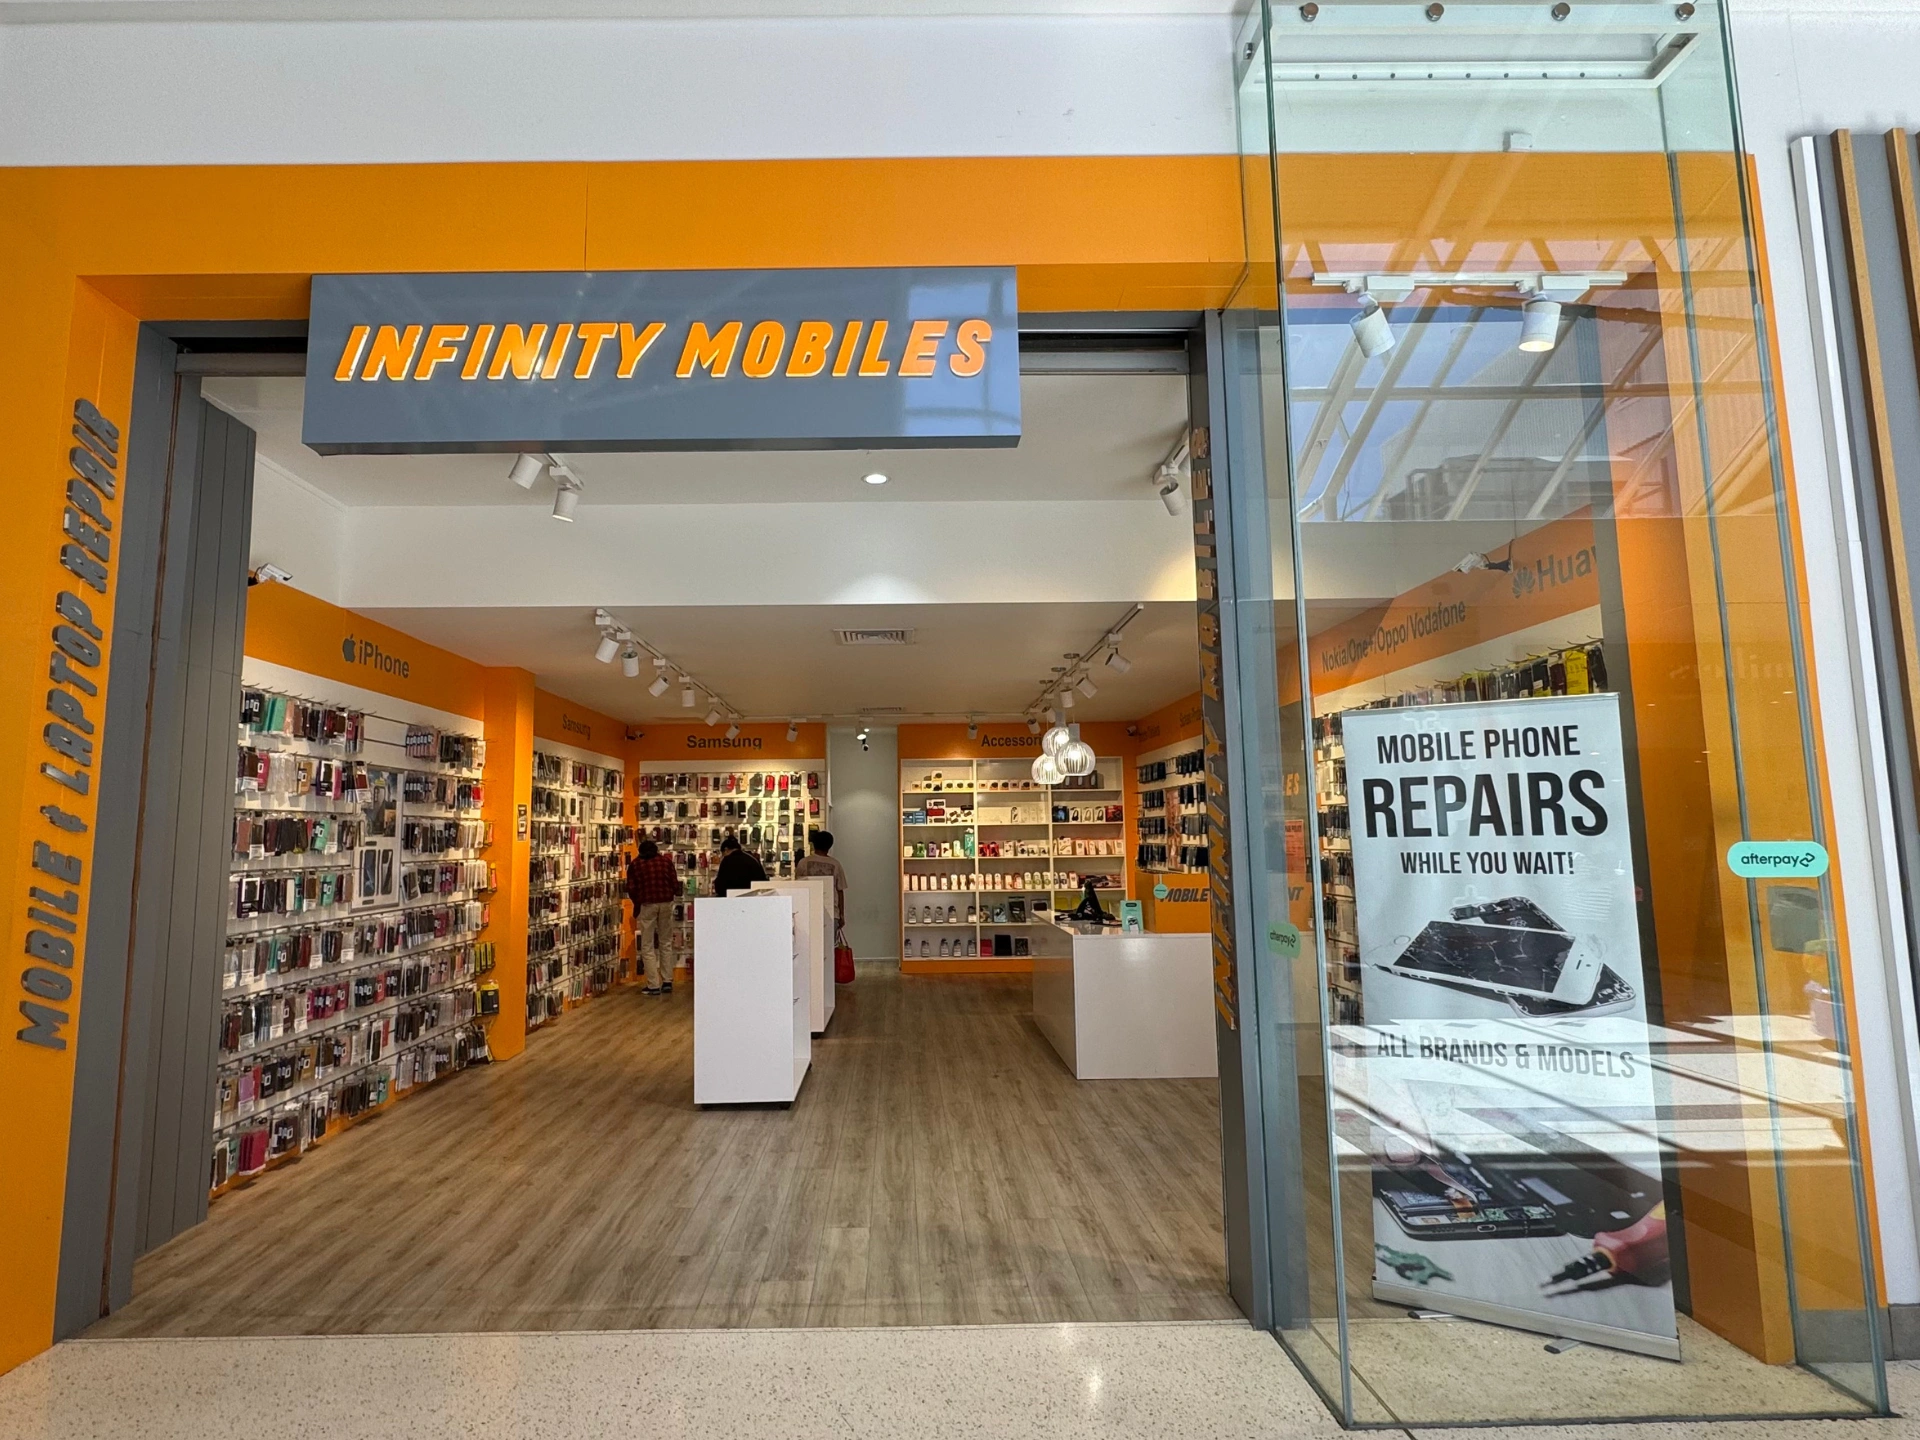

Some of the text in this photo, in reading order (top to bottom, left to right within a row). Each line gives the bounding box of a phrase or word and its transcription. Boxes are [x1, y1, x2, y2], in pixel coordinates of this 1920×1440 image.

[334, 319, 992, 382] INFINITY MOBILES
[60, 398, 119, 594] REPAIR
[359, 640, 410, 678] iPhone
[39, 590, 103, 796] LAPTOP
[562, 713, 591, 741] Samsung
[686, 734, 762, 751] Samsung
[1190, 426, 1237, 1031] INFINITY MOBILES
[1377, 725, 1581, 764] MOBILE PHONE
[1362, 769, 1608, 838] REPAIRS
[1401, 851, 1575, 875] WHILE YOU WAIT!
[1741, 853, 1800, 868] afterpay
[1161, 887, 1210, 902] MOBILE
[16, 839, 83, 1050] MOBILE
[1377, 1032, 1636, 1079] ALL BRANDS & MODELS
